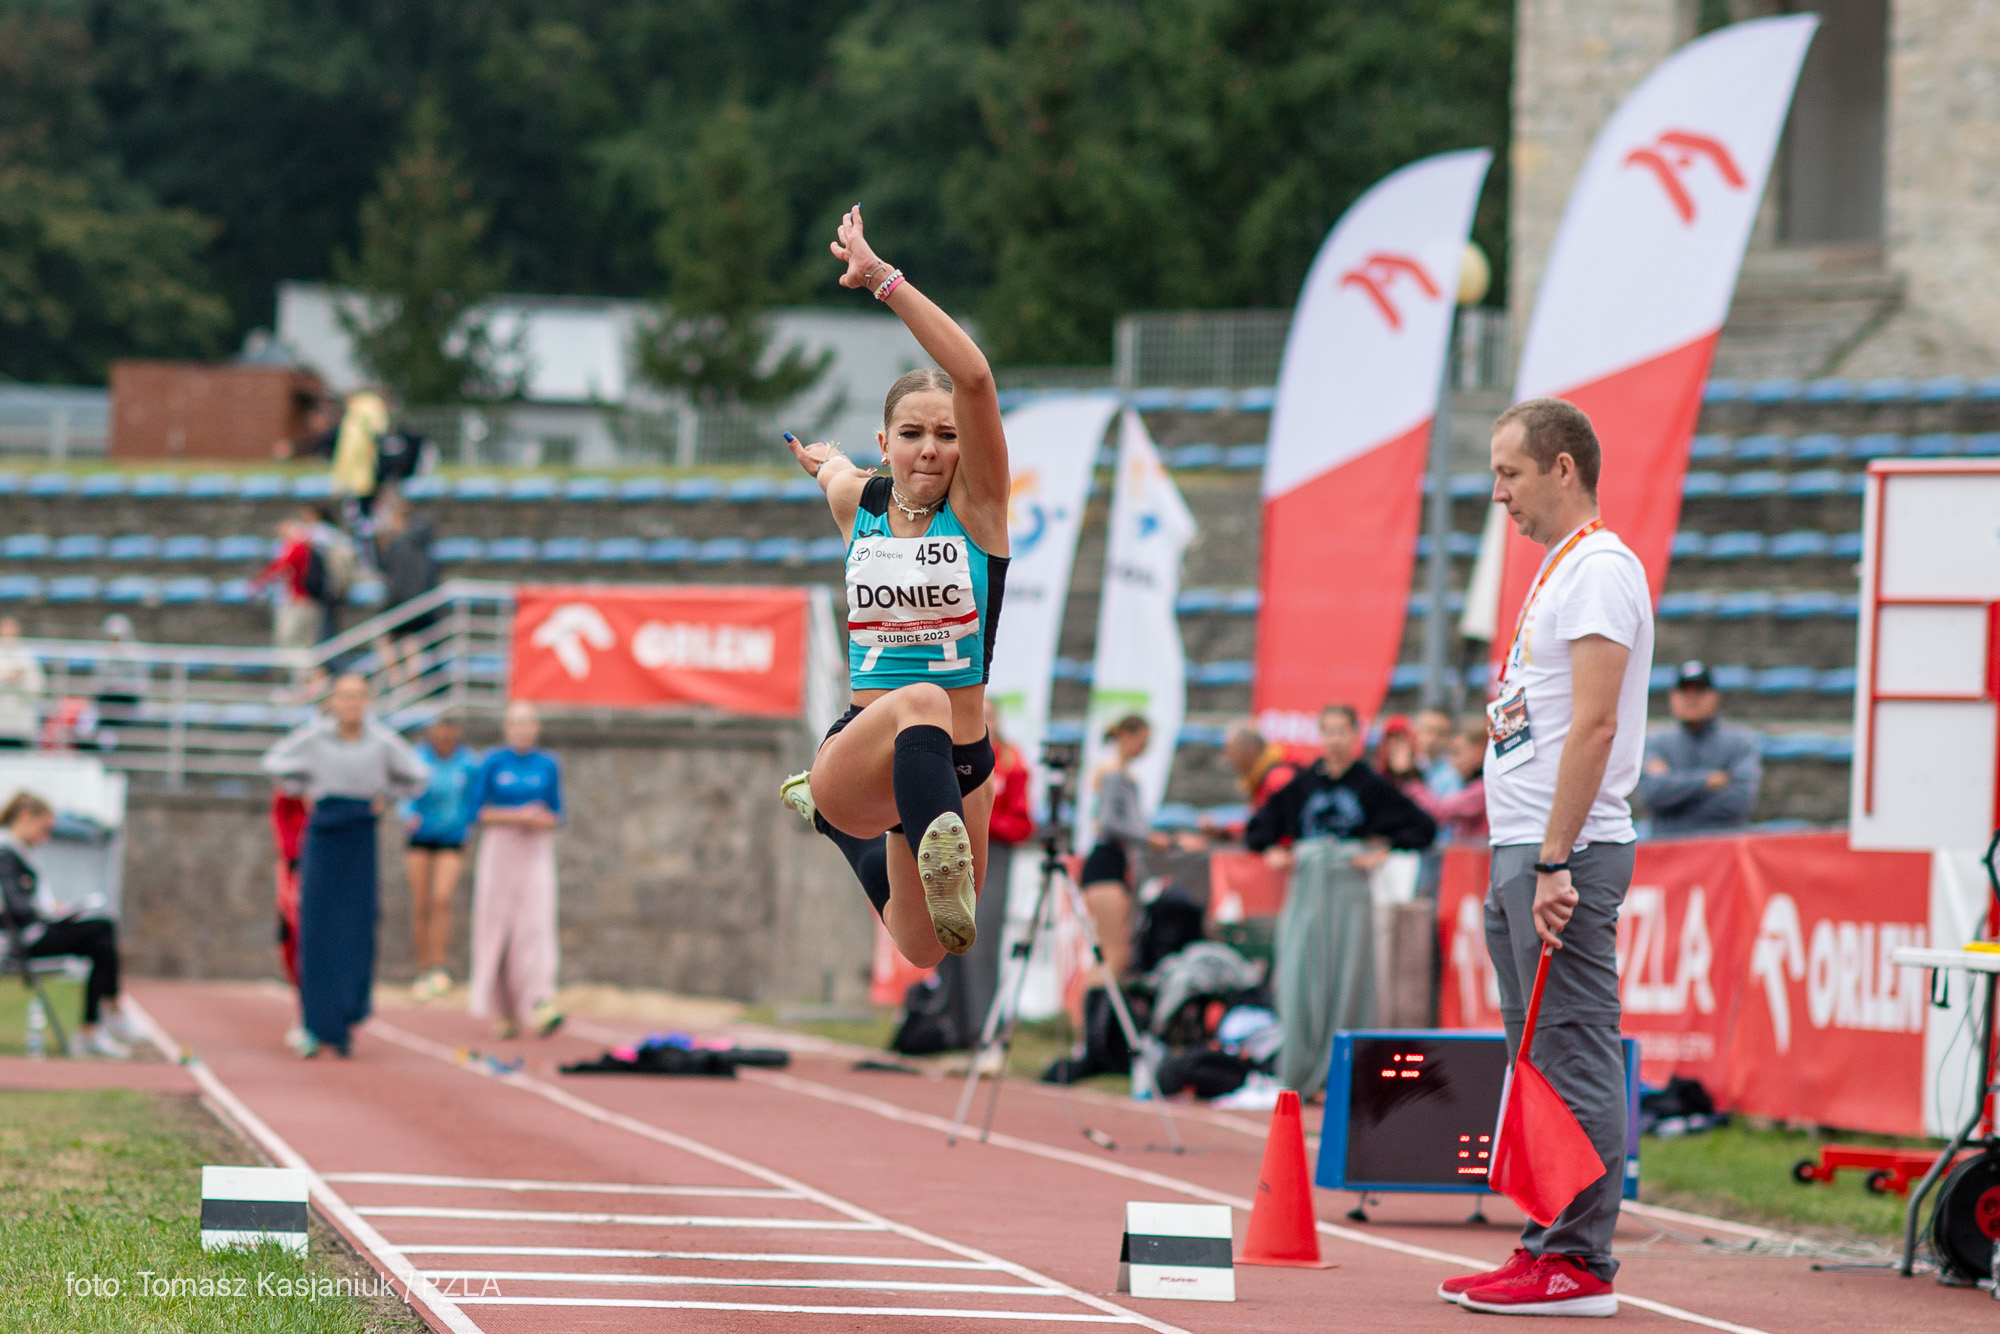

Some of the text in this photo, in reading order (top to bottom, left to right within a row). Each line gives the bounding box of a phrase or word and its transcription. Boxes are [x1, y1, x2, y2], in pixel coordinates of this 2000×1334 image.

[875, 542, 958, 566] Okęcie 450
[856, 583, 961, 609] DONIEC
[631, 619, 776, 673] ORLEN
[877, 630, 951, 643] SŁUBICE 2023
[1805, 918, 1927, 1034] ORLEN
